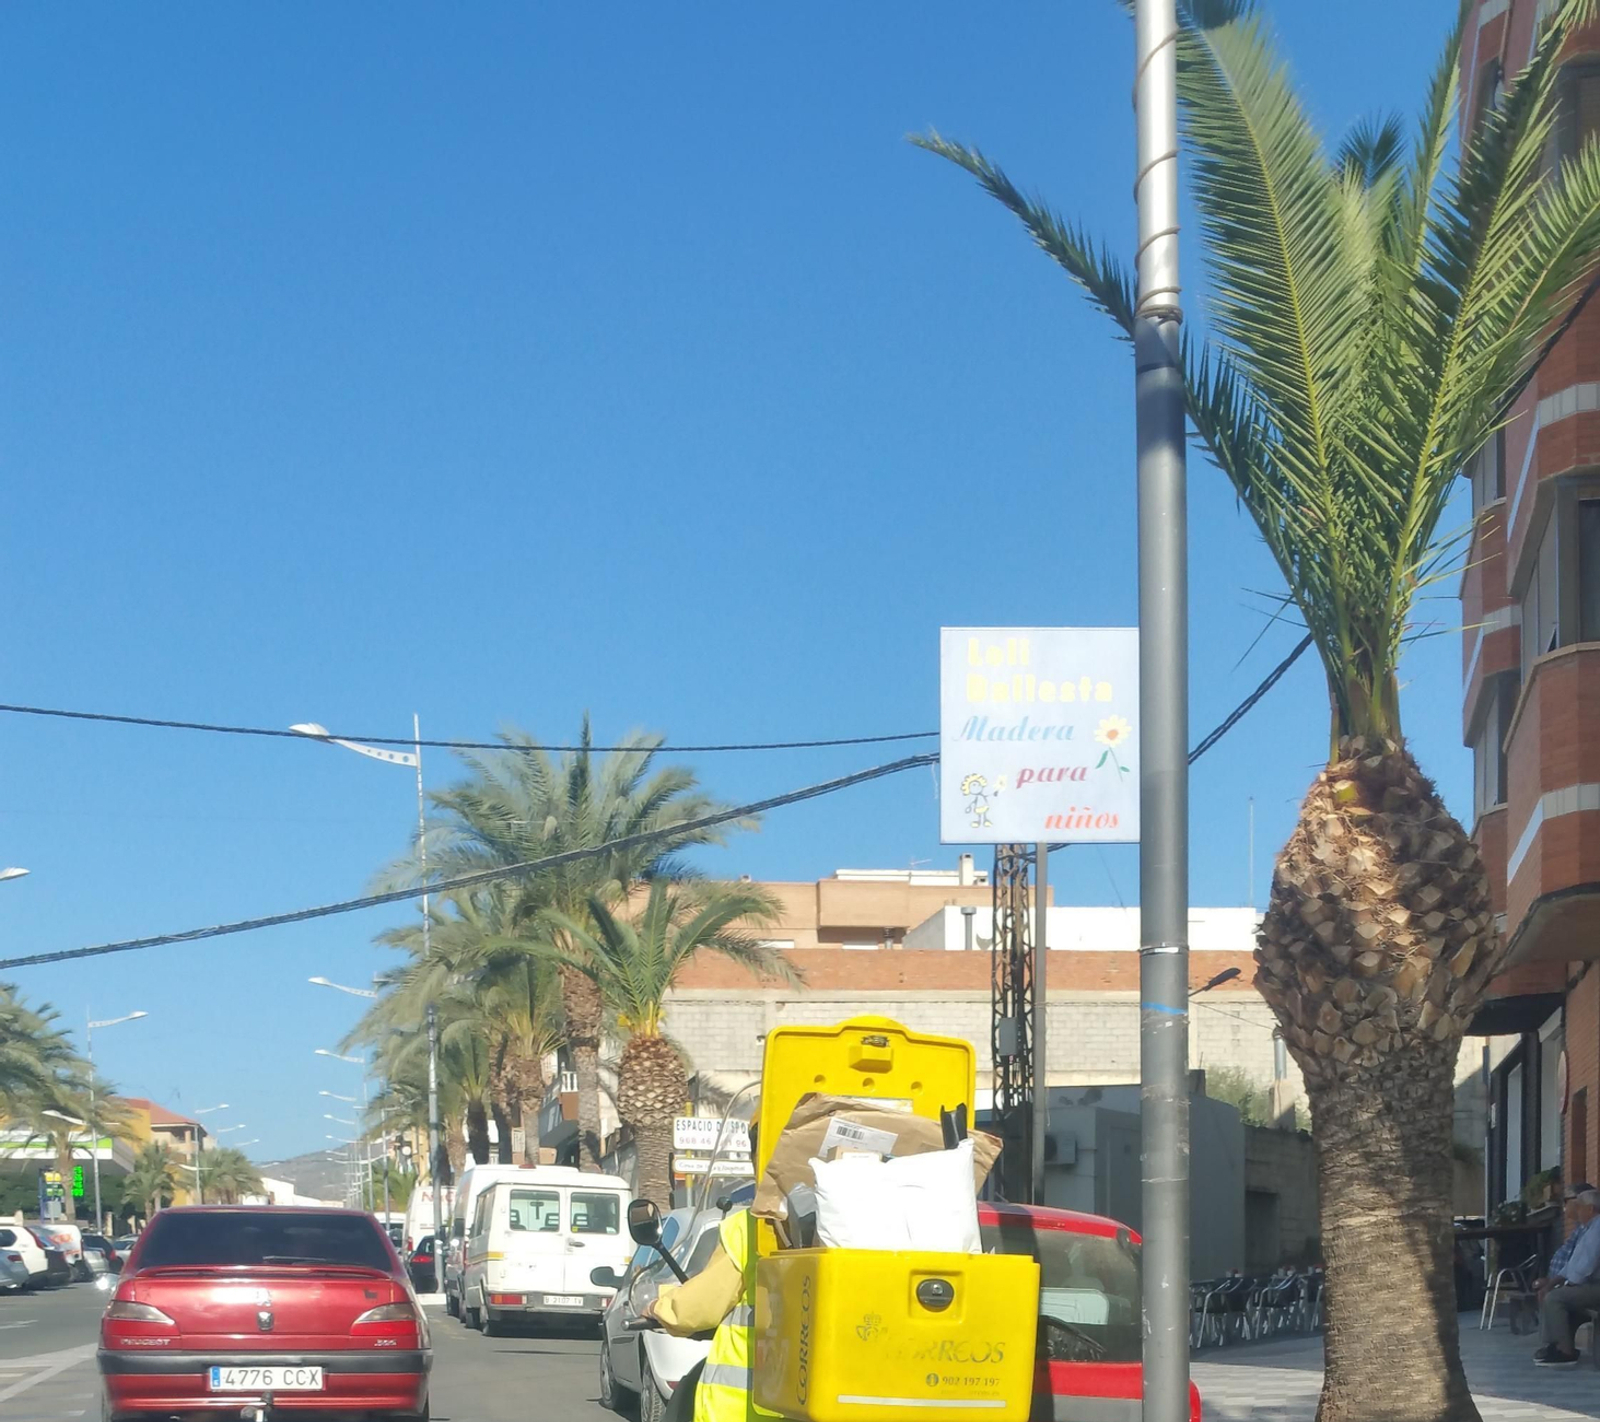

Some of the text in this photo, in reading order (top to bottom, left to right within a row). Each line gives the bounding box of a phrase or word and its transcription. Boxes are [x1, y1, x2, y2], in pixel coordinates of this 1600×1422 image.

[968, 637, 1030, 667] Loli
[953, 715, 1076, 741] Madera
[1016, 766, 1088, 789] para
[1044, 806, 1119, 830] niños
[676, 1119, 713, 1132] ESPACIO
[224, 1369, 319, 1387] 4776 CCX
[942, 1376, 1001, 1387] 902 197 197
